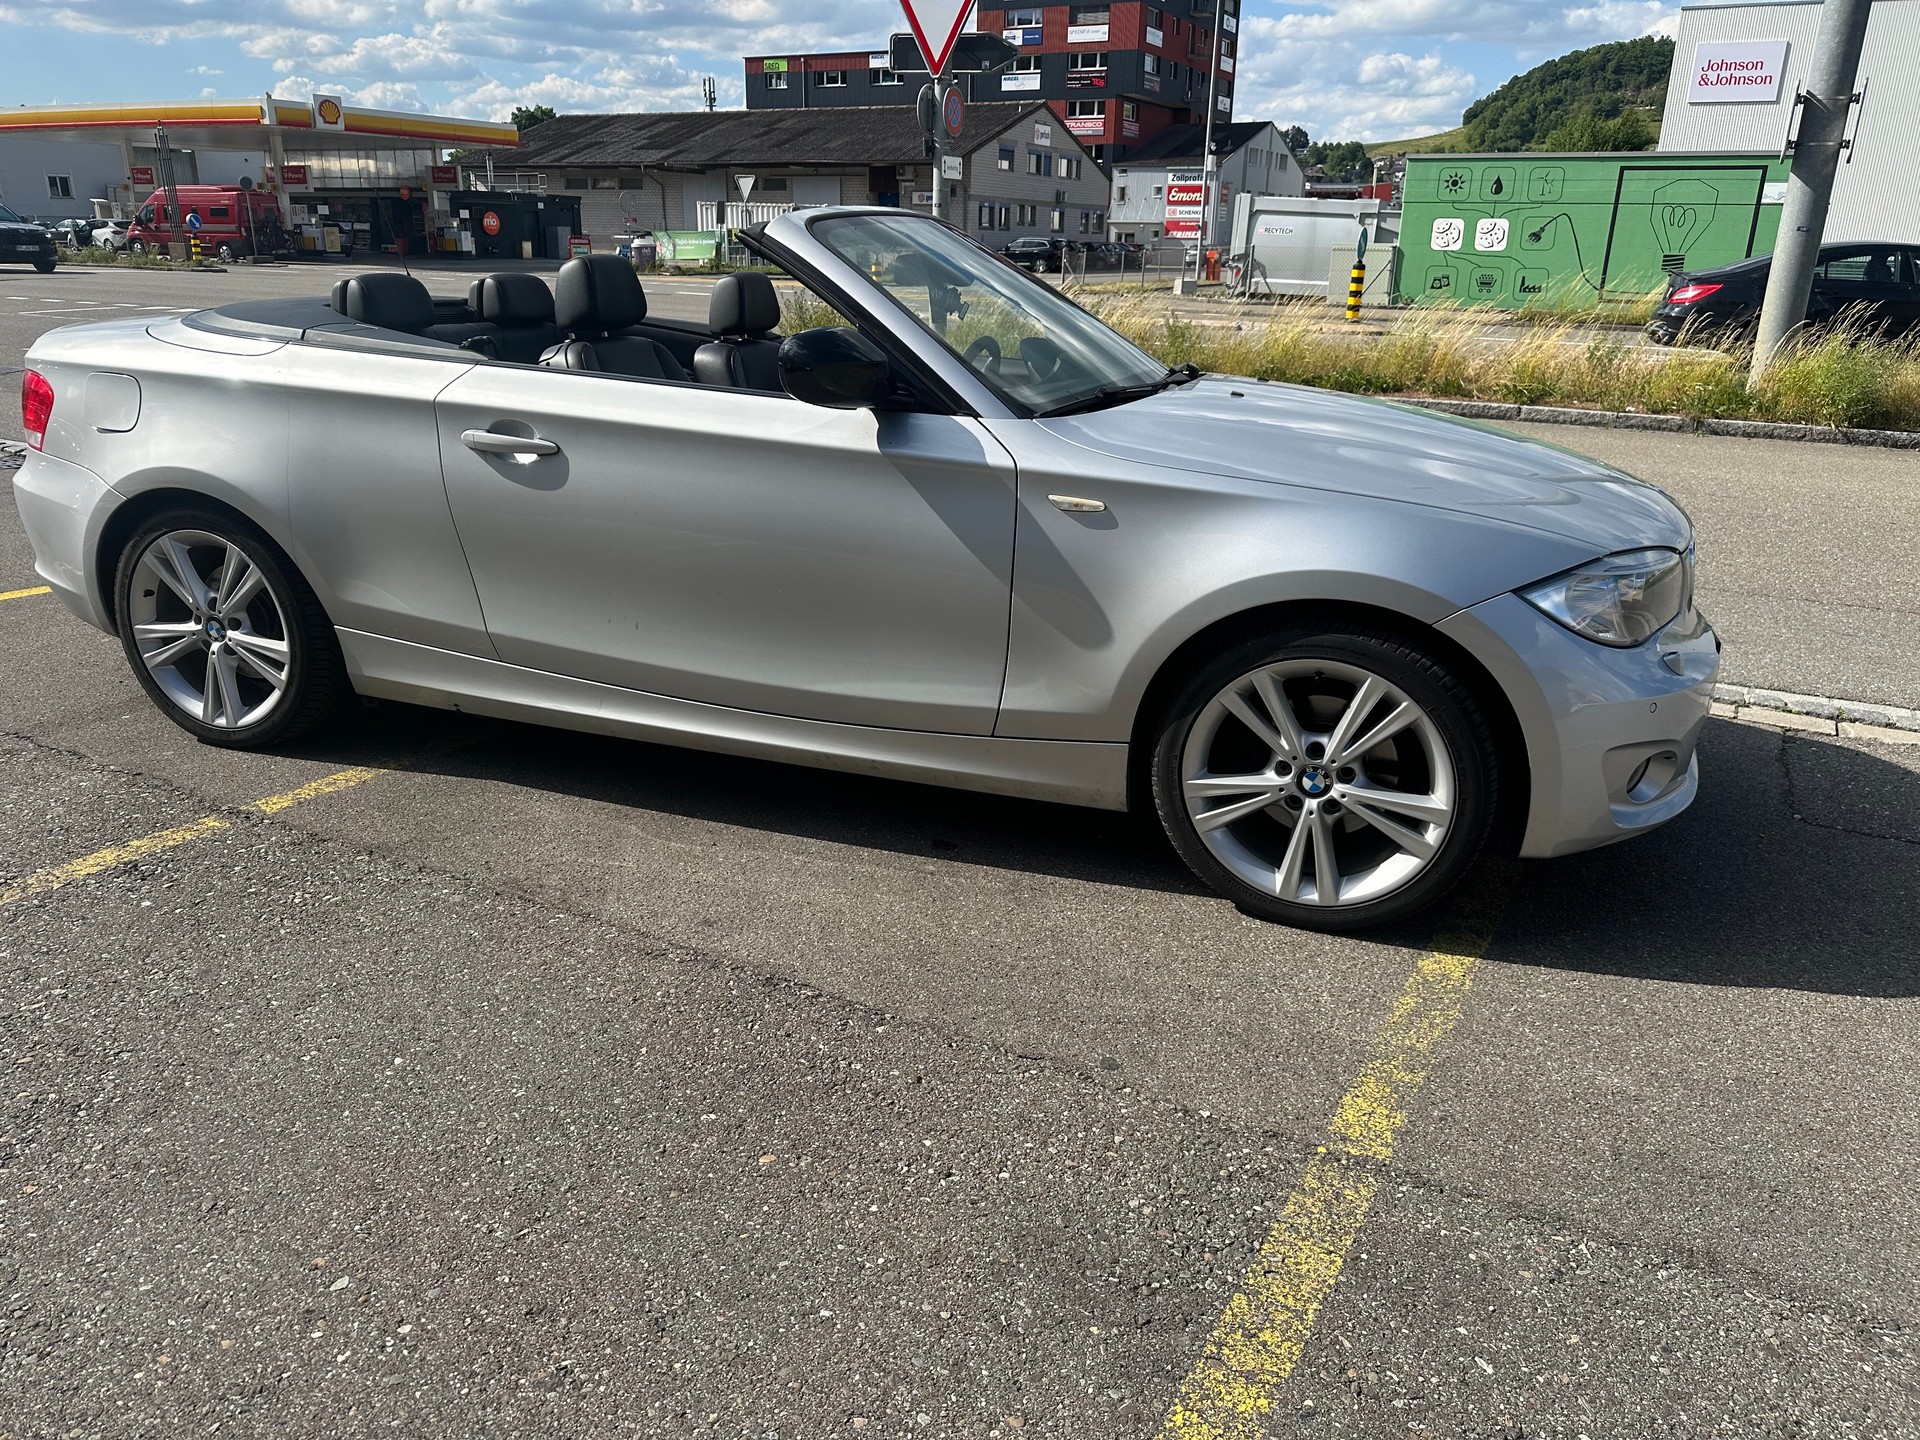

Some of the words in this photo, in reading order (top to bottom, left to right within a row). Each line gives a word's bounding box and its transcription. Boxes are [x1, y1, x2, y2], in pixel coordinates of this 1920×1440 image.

[1701, 59, 1764, 73] Johnson
[1698, 73, 1773, 87] &Johnson
[283, 171, 305, 179] V-Power
[1168, 187, 1203, 202] Emon
[1264, 227, 1293, 235] RECYTECH
[1305, 766, 1332, 785] BMW
